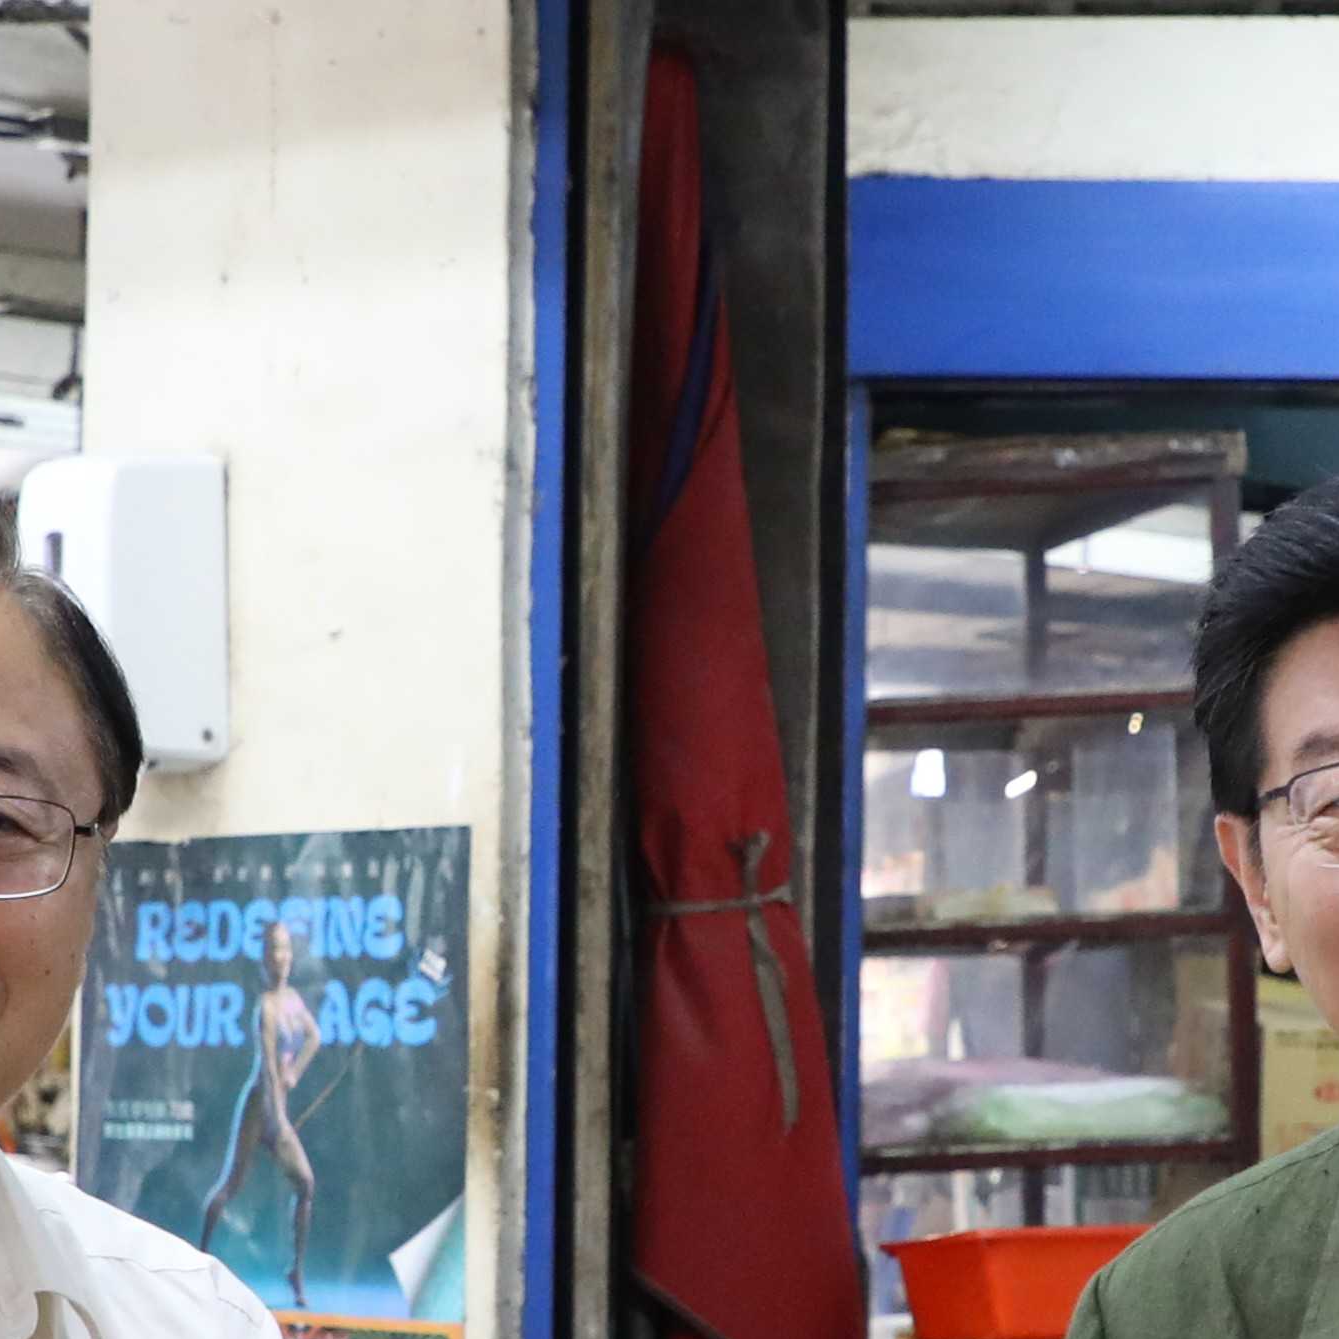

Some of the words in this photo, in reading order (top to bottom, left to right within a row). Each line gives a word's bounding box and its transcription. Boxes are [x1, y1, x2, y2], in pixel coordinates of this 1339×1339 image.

[134, 894, 405, 962] REDEFINE
[104, 981, 246, 1048] YOUR
[319, 977, 438, 1048] AGE
